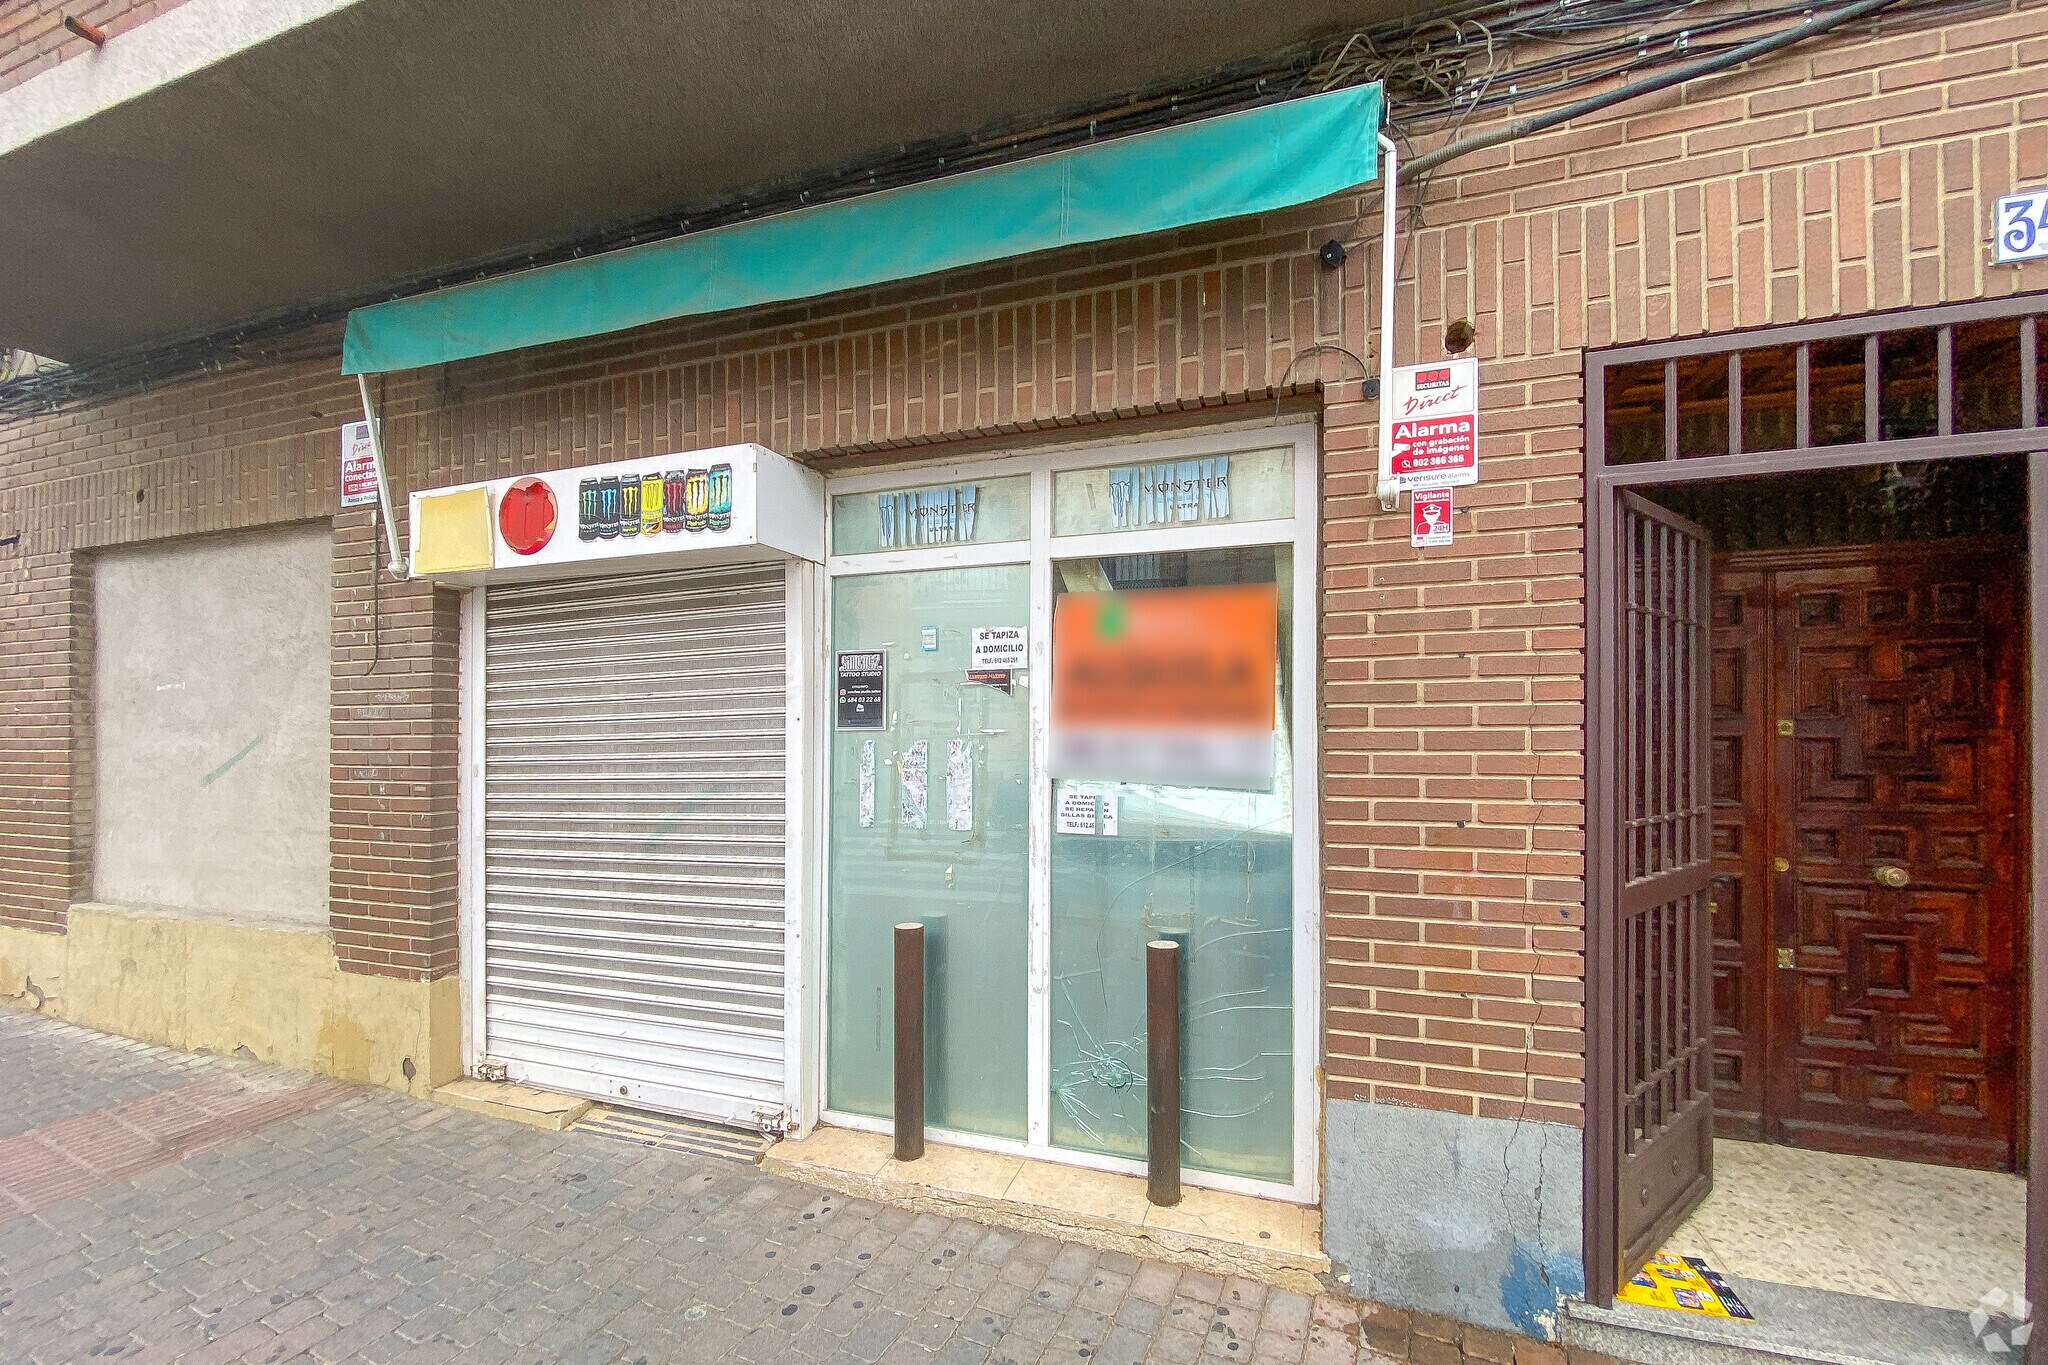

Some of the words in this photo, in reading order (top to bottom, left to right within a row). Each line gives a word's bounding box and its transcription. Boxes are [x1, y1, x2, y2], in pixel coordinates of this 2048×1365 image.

[1403, 385, 1468, 415] Direct
[1394, 421, 1471, 440] Alarma
[1428, 435, 1470, 448] grabación
[1412, 448, 1424, 456] de
[1426, 444, 1470, 455] imágenes
[345, 461, 376, 473] Alarm
[1412, 457, 1429, 467] 902
[344, 471, 378, 482] conectad
[1407, 473, 1446, 482] verisure
[1414, 491, 1450, 501] Vigilante
[1433, 524, 1449, 532] 24H
[979, 632, 990, 640] SE
[991, 630, 1019, 640] TAPIZA
[975, 645, 981, 654] A
[983, 643, 1024, 654] DOMICILIO
